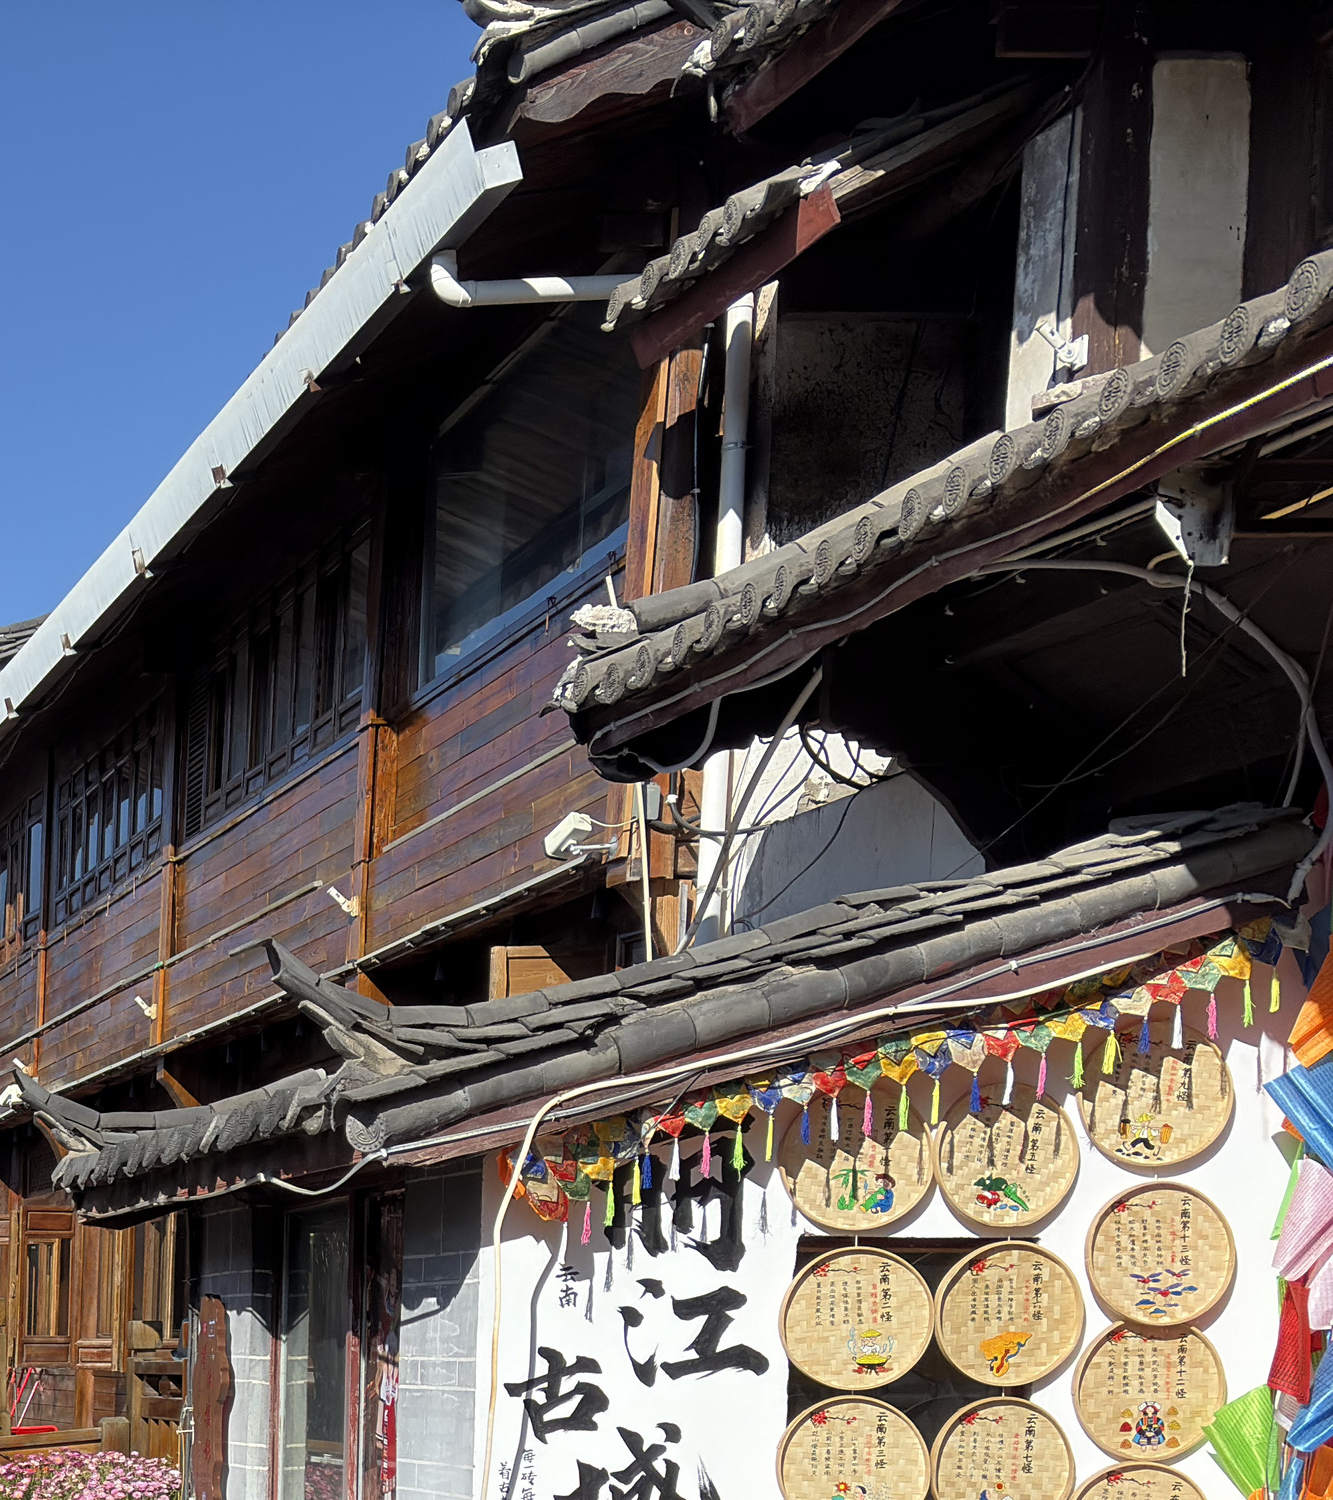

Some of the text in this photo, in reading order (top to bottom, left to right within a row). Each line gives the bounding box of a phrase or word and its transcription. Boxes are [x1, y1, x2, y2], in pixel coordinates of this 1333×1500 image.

[1177, 1041, 1195, 1101] 云南第九怪
[1026, 1109, 1045, 1175] 云南第五怪
[1180, 1196, 1191, 1266] 云南第十三怪
[555, 1263, 579, 1308] 云南
[879, 1262, 893, 1322] 云南第二怪
[1032, 1261, 1044, 1321] 云南第六怪
[1176, 1333, 1188, 1399] 云南第十二怪
[875, 1412, 888, 1469] 云南第三怪
[1022, 1414, 1038, 1474] 云南第七怪
